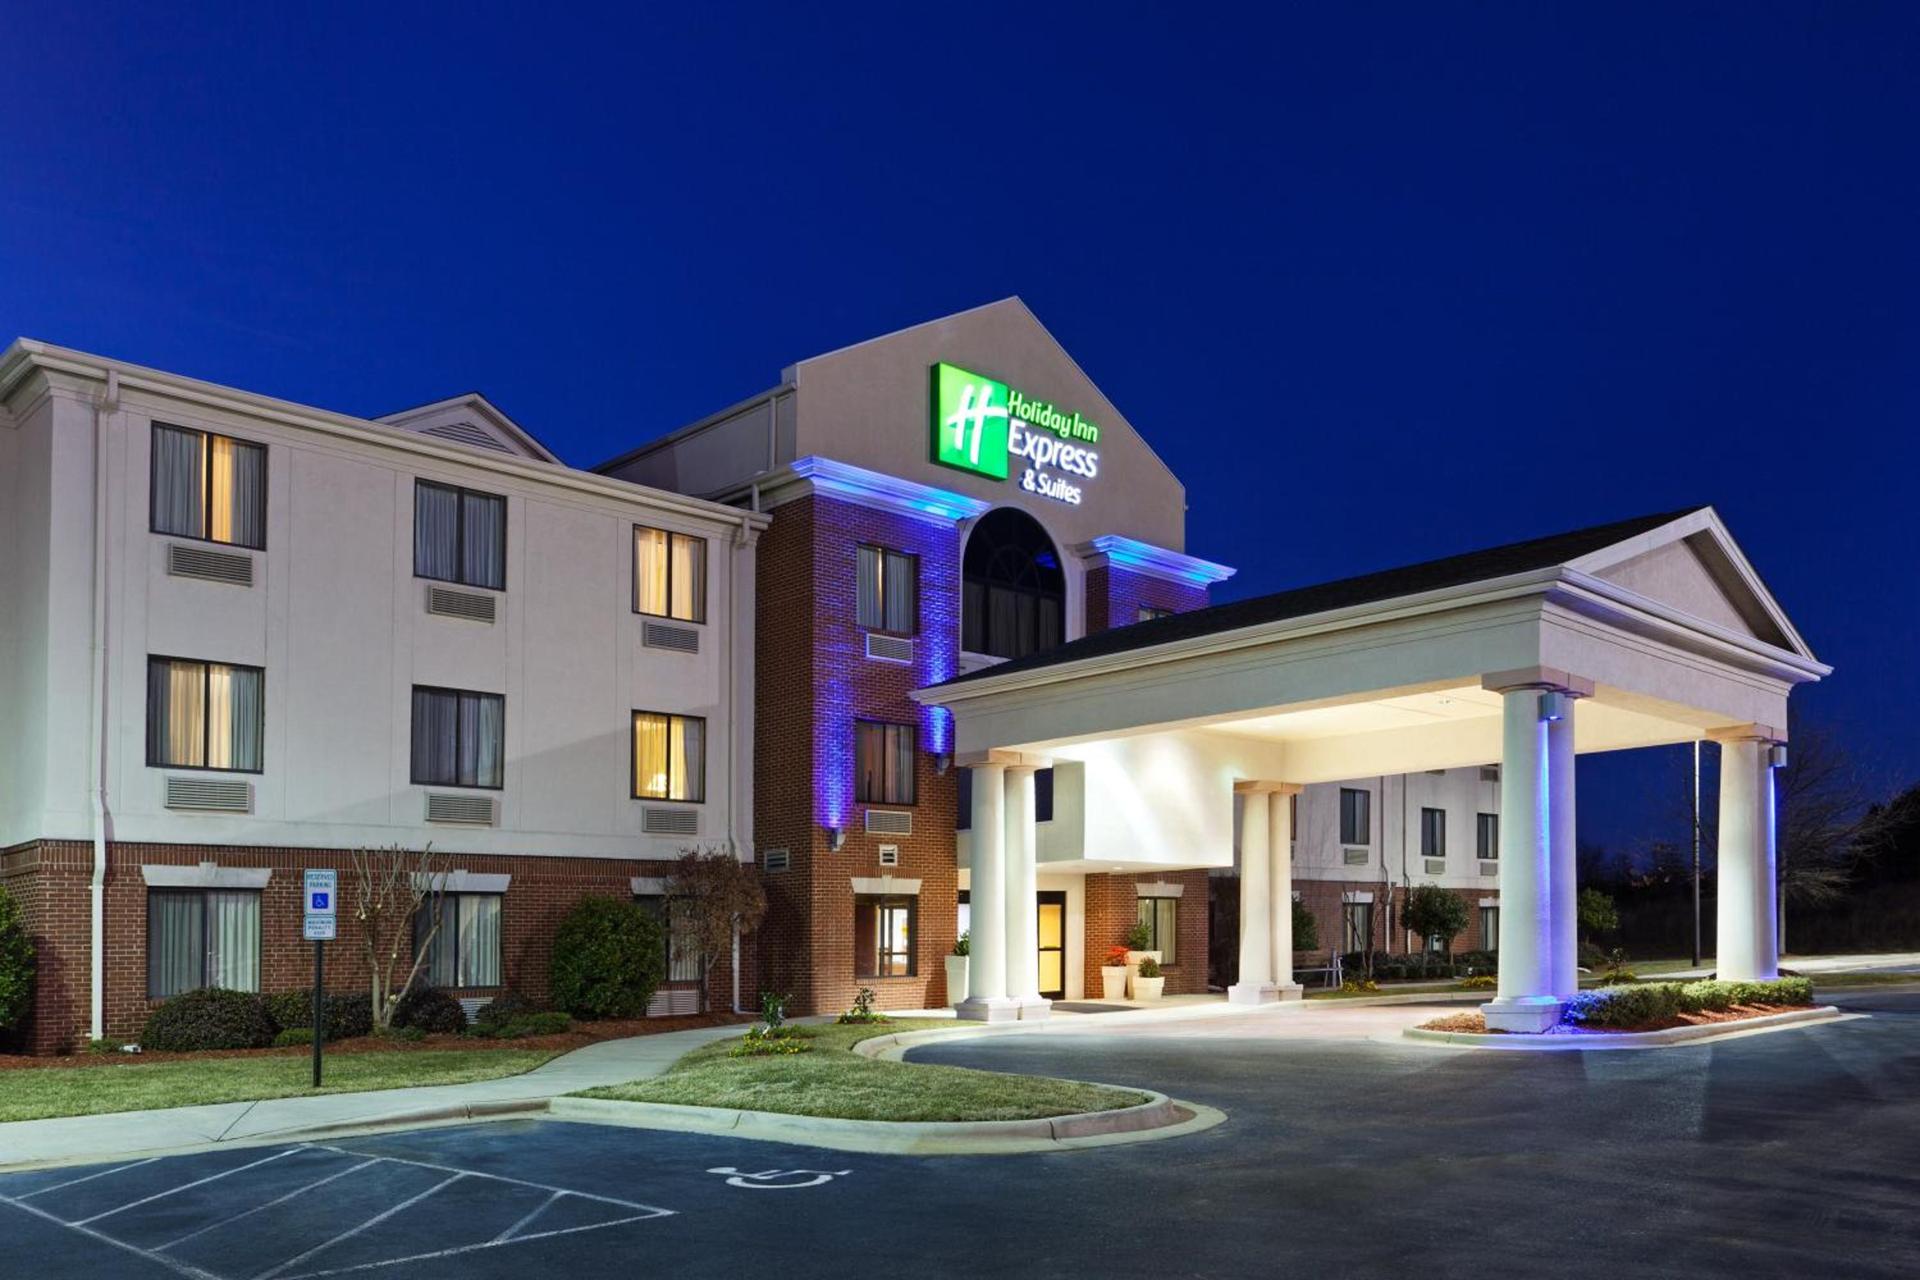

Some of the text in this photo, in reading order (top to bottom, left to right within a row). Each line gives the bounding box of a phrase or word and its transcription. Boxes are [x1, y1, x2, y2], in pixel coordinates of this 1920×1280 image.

[1008, 390, 1098, 442] Holiday Inn
[1008, 419, 1098, 478] Express
[1023, 469, 1081, 505] & Suites
